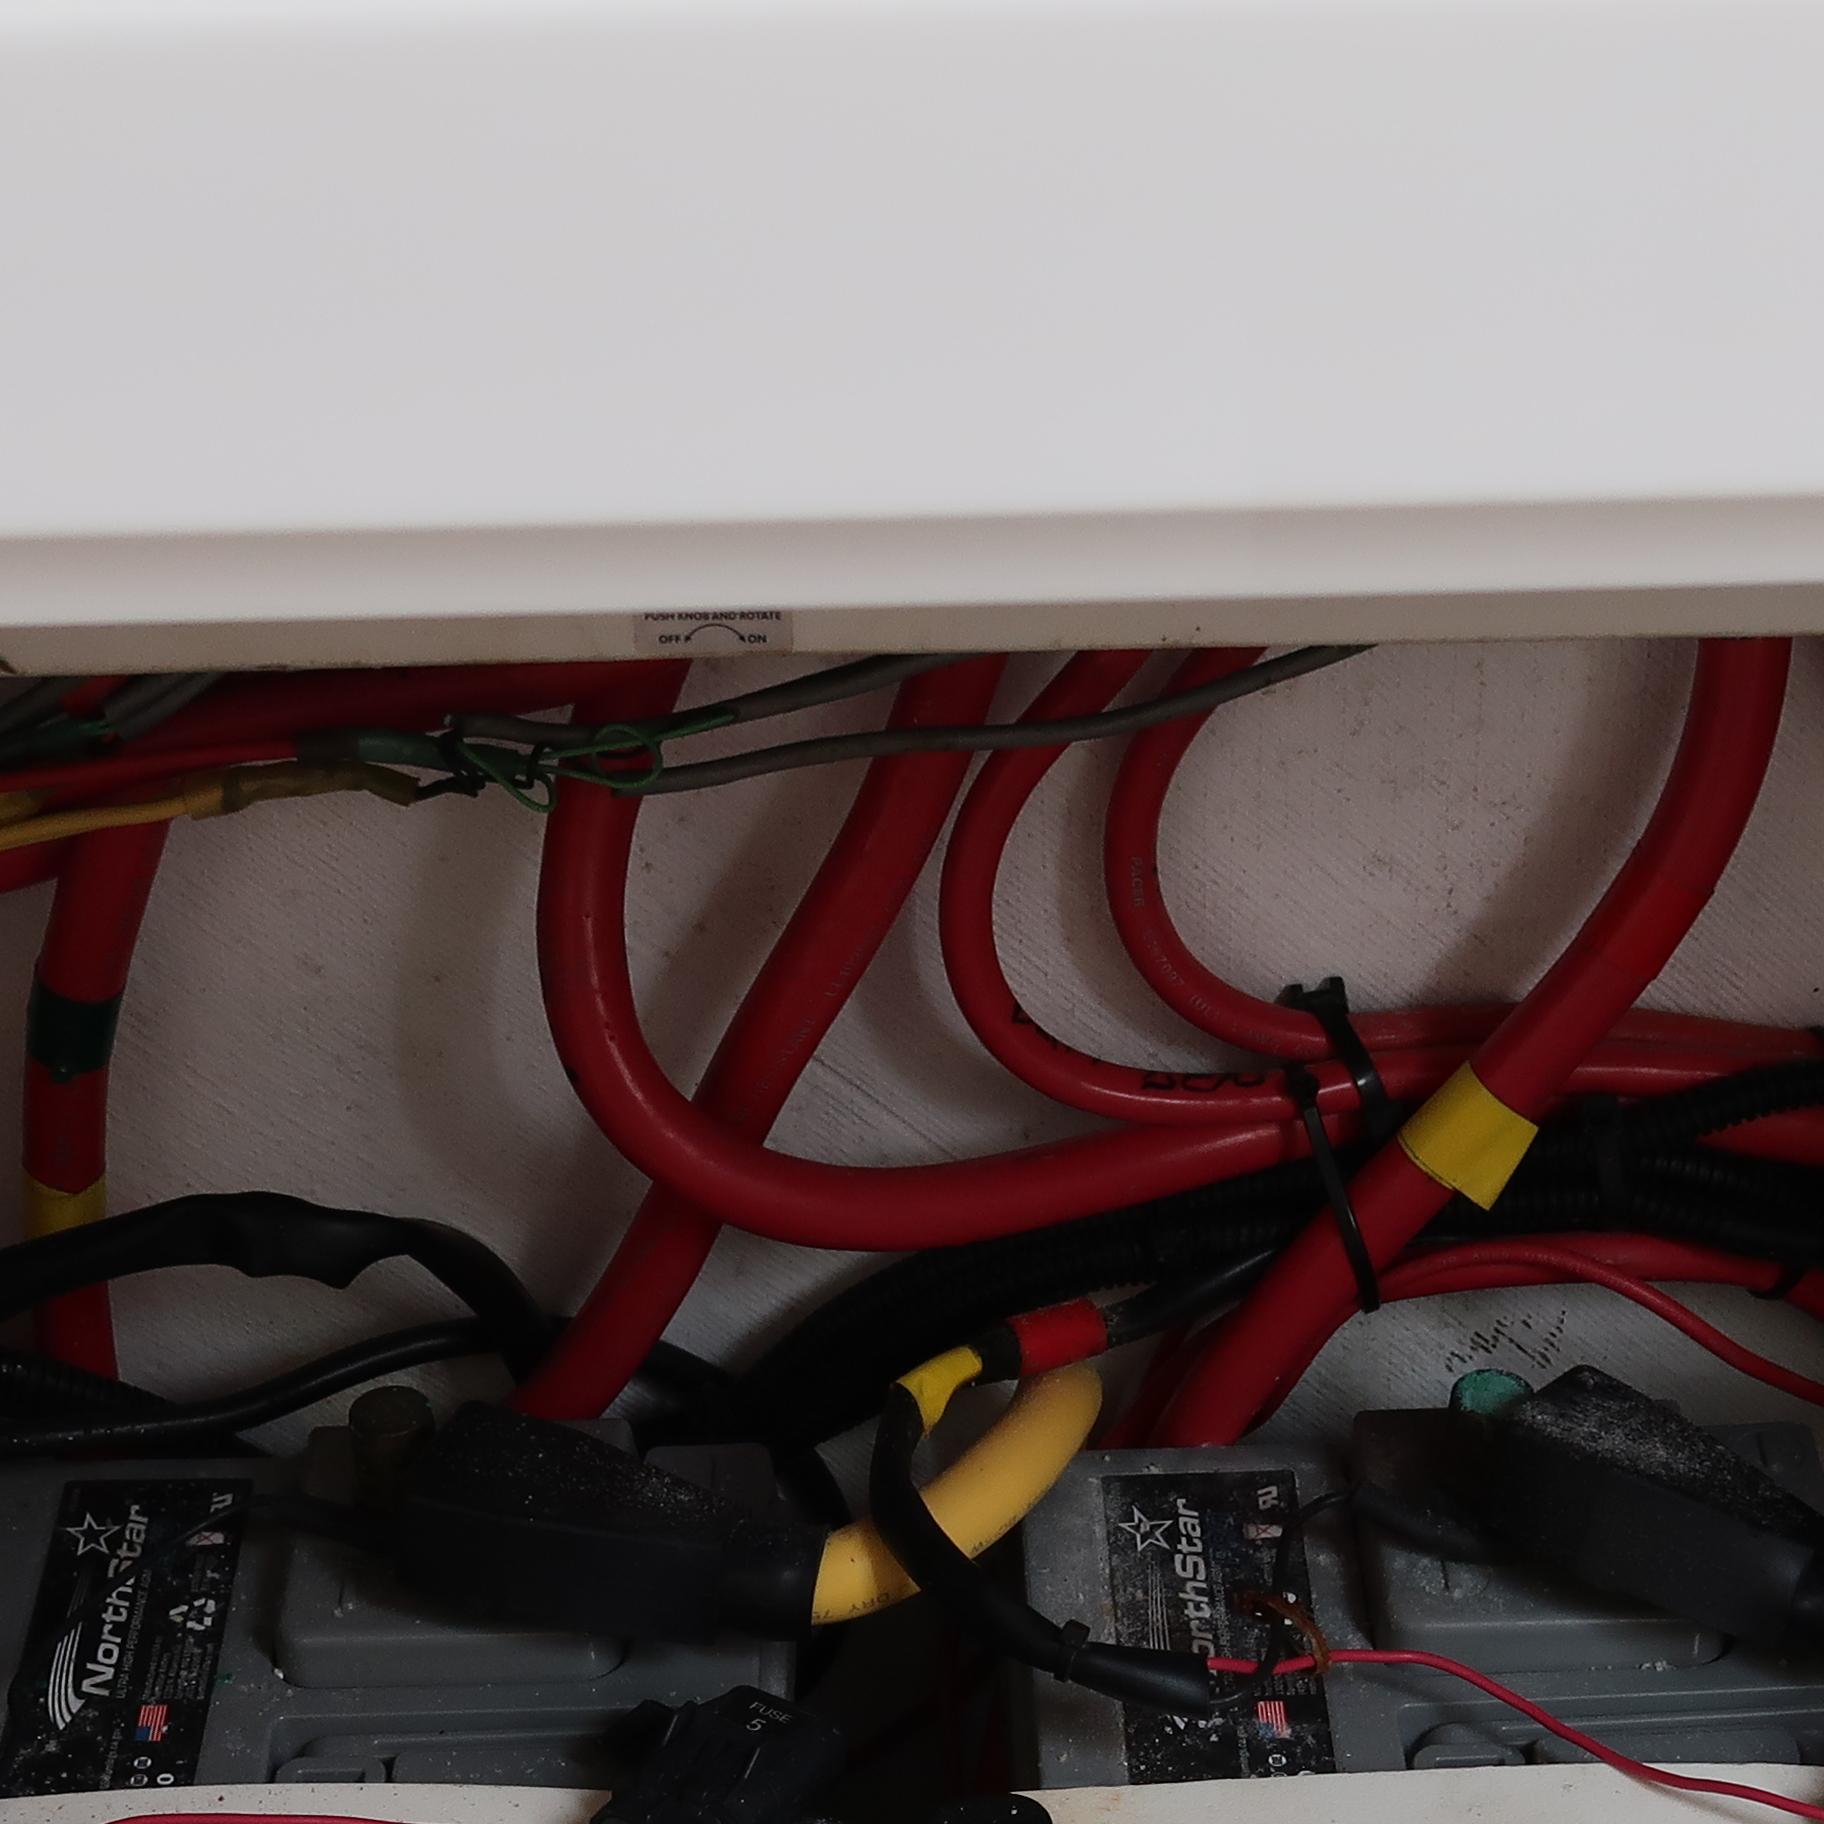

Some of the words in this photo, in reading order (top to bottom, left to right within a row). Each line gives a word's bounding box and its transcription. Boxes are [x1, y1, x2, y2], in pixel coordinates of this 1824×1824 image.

[644, 611, 675, 621] PUSH
[678, 611, 709, 621] KNOB
[711, 611, 737, 621] AND
[739, 610, 782, 621] ROTATE
[659, 634, 681, 644] OFF
[747, 634, 768, 644] ON
[1174, 1497, 1216, 1656] orthStar
[748, 1701, 793, 1725] FUSE
[745, 1717, 767, 1732] 5
